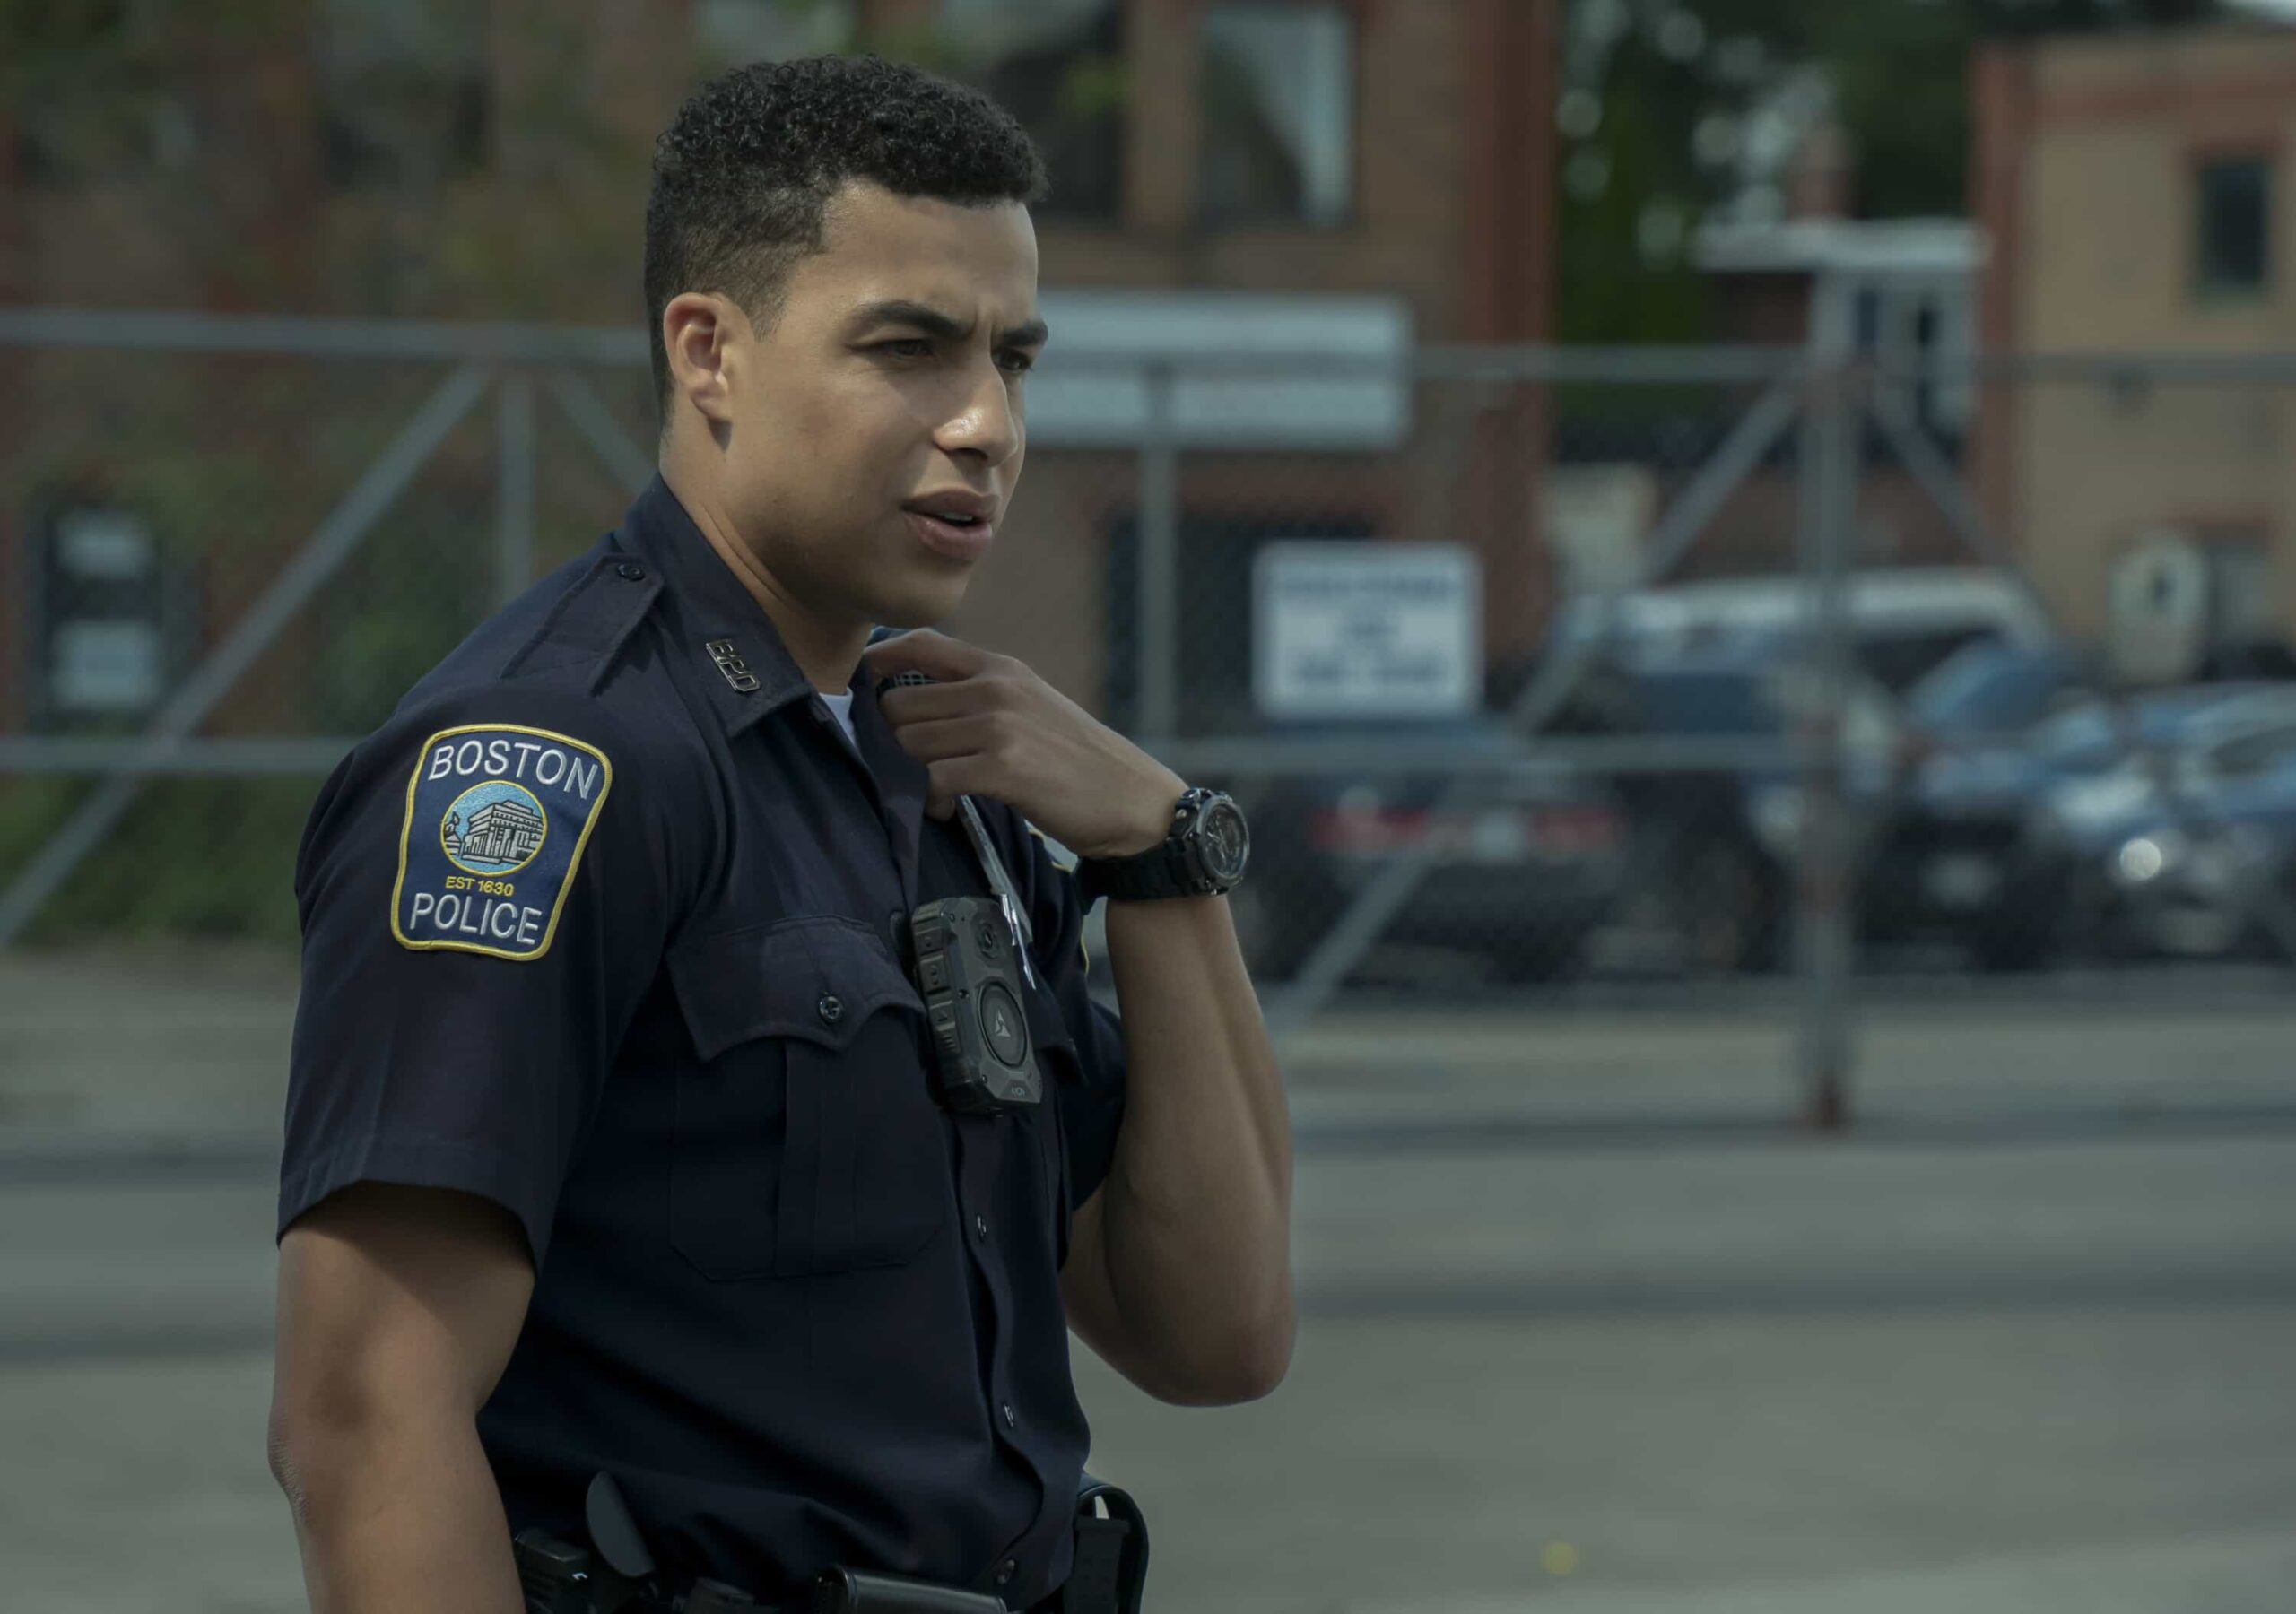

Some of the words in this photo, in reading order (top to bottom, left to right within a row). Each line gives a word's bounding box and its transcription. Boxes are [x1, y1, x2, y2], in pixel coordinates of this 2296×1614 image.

[705, 638, 761, 692] BPD
[428, 740, 598, 799] BOSTON
[446, 875, 475, 890] EST
[479, 879, 514, 896] 1630
[410, 893, 542, 944] POLICE
